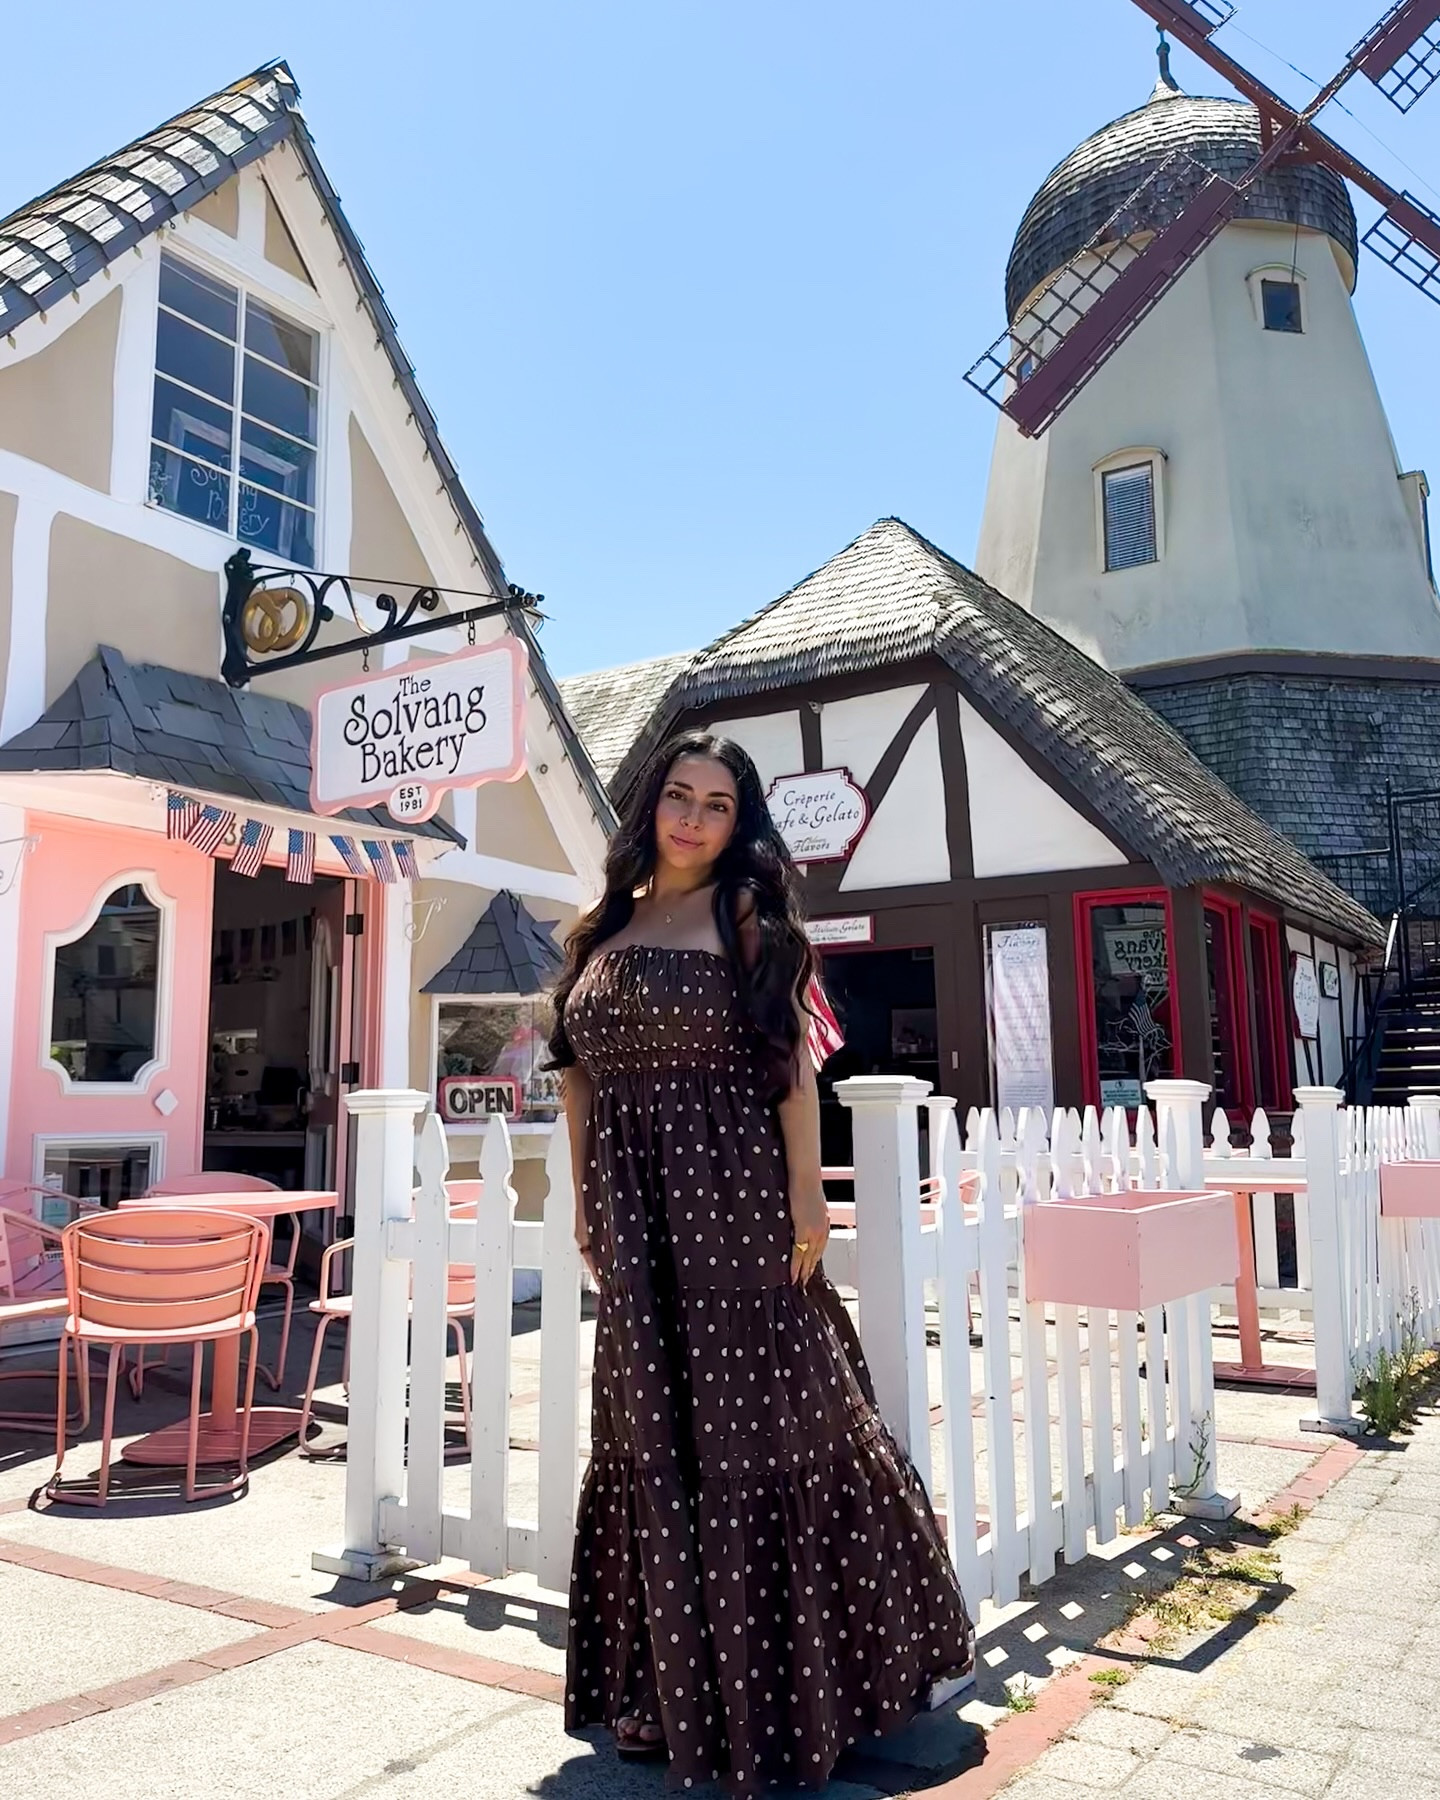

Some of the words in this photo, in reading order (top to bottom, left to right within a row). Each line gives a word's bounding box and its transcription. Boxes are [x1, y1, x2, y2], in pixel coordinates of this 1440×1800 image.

[399, 674, 432, 697] The
[344, 685, 487, 745] Solvang
[361, 732, 467, 783] Bakery
[399, 785, 422, 799] EST
[400, 798, 423, 812] 1981
[770, 808, 796, 833] afe
[798, 812, 809, 825] &
[809, 801, 860, 829] Gelato
[790, 837, 830, 854] Flavors
[449, 1087, 514, 1114] OPEN
